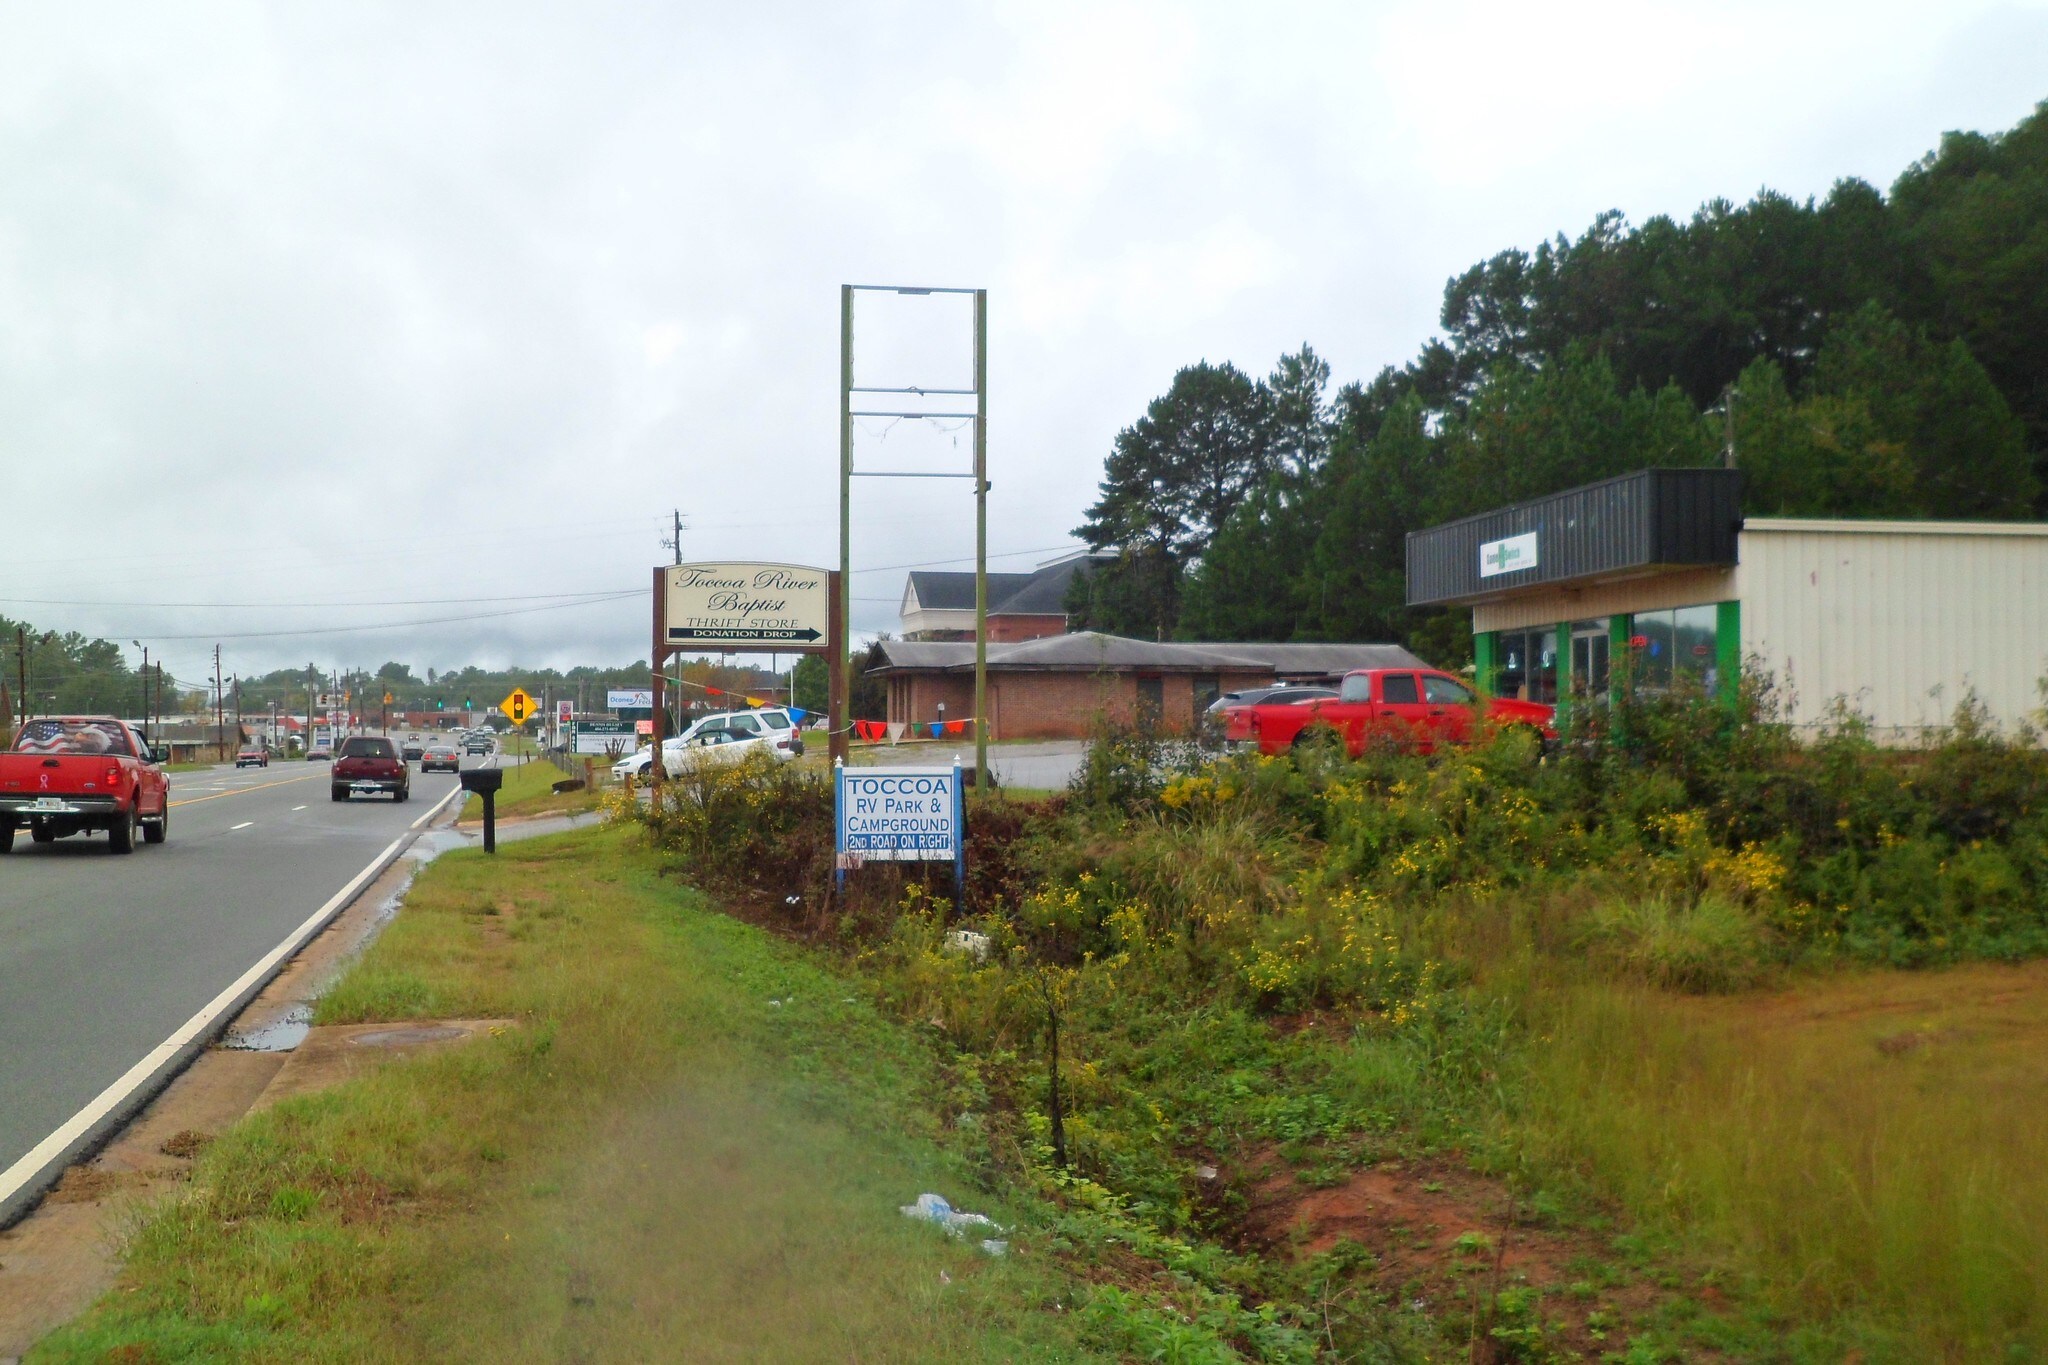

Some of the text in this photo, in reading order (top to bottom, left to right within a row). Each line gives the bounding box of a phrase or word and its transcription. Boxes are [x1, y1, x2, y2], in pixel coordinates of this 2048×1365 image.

[675, 568, 819, 590] Toccoa River
[707, 591, 786, 617] Baptist
[686, 617, 799, 629] THRIFT STORE
[693, 629, 796, 638] DONATION DROP
[847, 779, 948, 795] TOCCOA
[856, 798, 878, 813] RV
[930, 798, 941, 813] &
[871, 835, 897, 849] ROAD
[901, 835, 915, 848] ON
[918, 835, 948, 849] RIGHT
